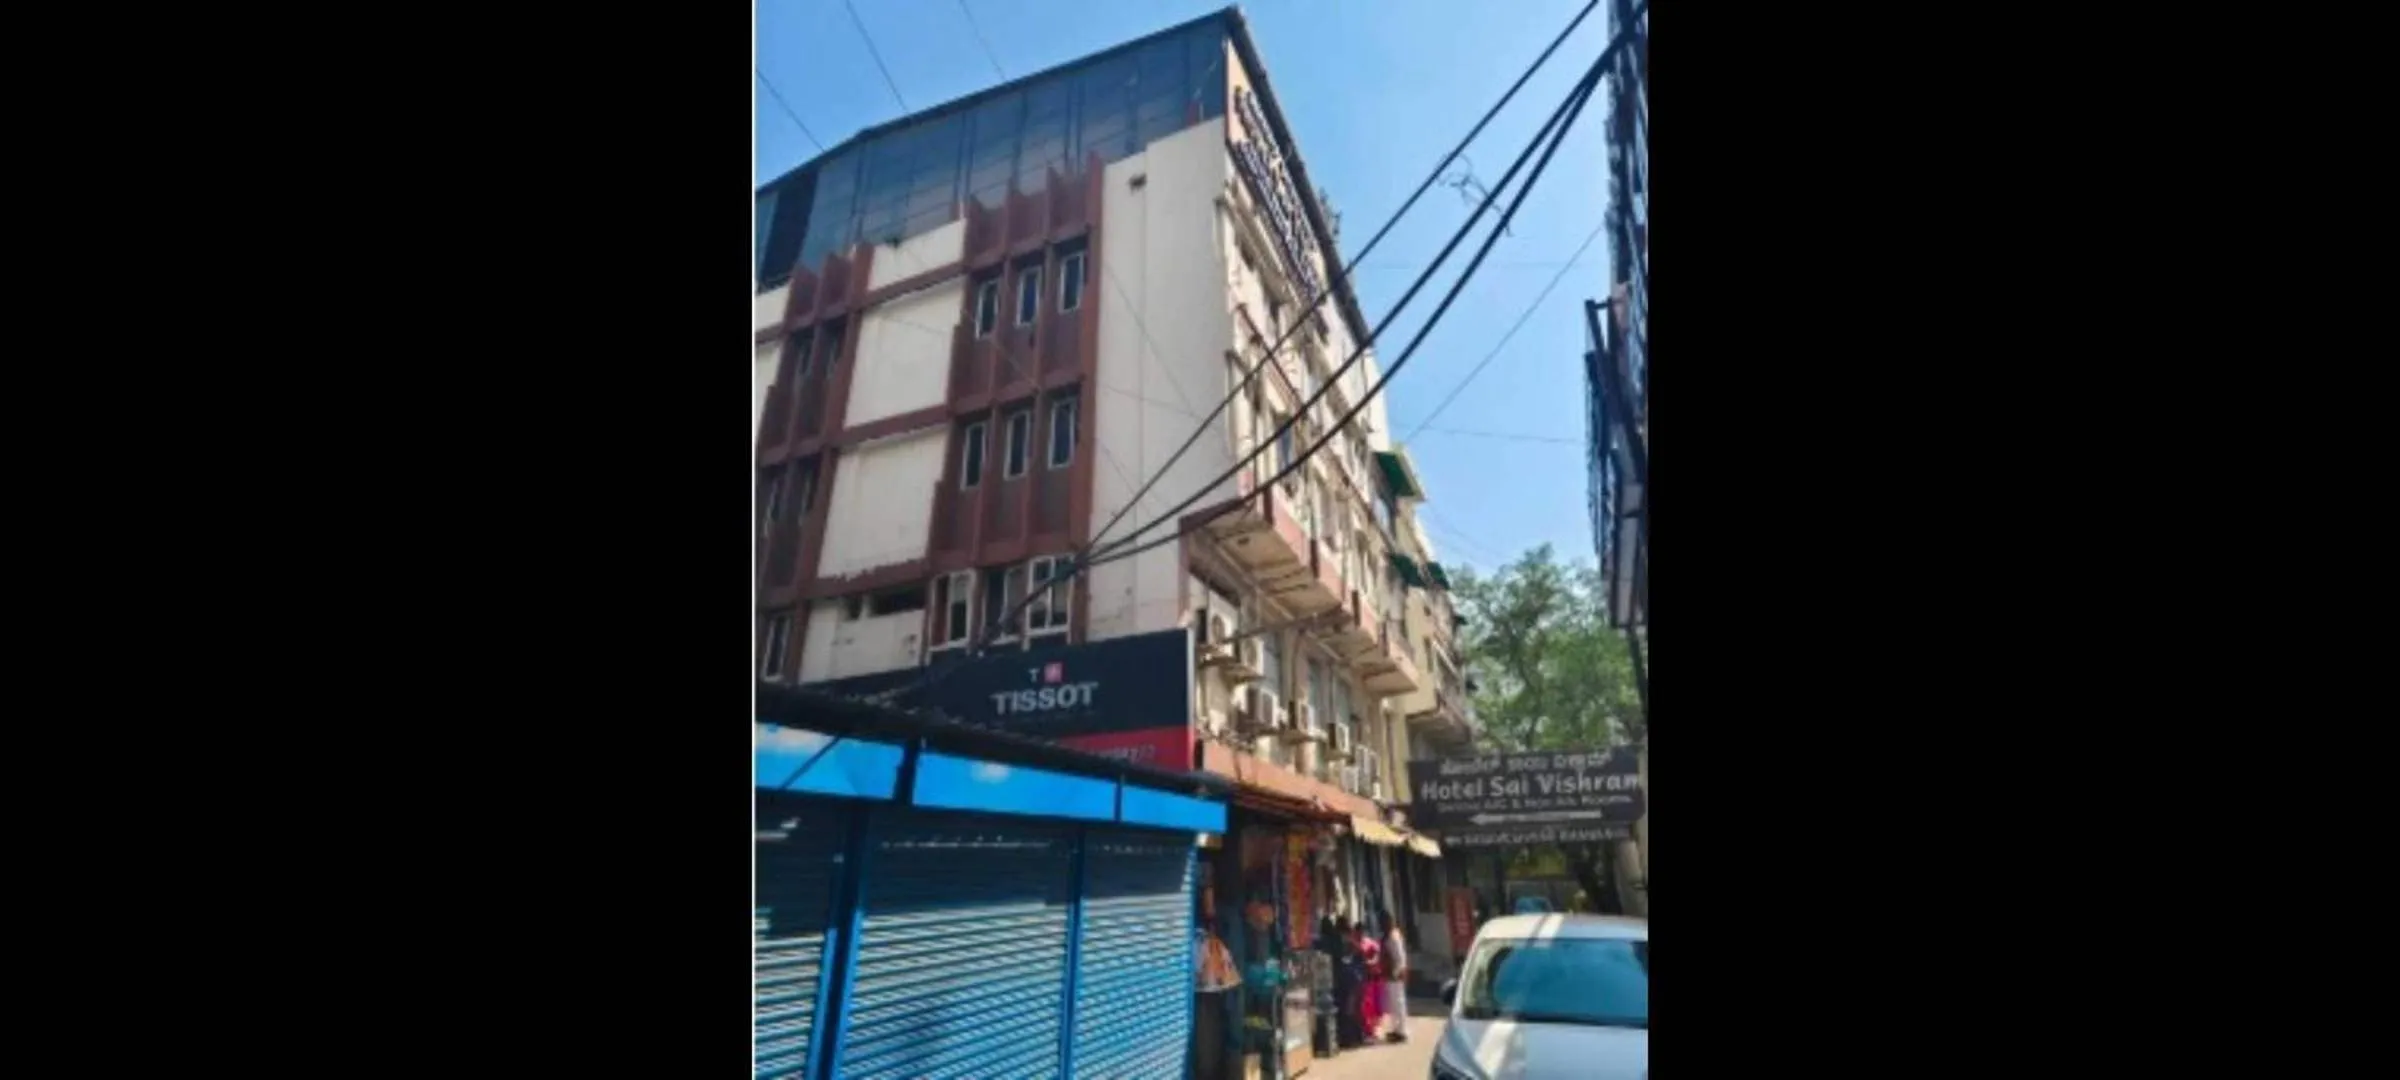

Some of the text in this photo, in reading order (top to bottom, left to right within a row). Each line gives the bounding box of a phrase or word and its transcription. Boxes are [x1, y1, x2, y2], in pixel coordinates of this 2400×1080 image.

[991, 681, 1100, 716] TISSOT
[1421, 777, 1482, 800] Hotel
[1489, 775, 1530, 797] Sai
